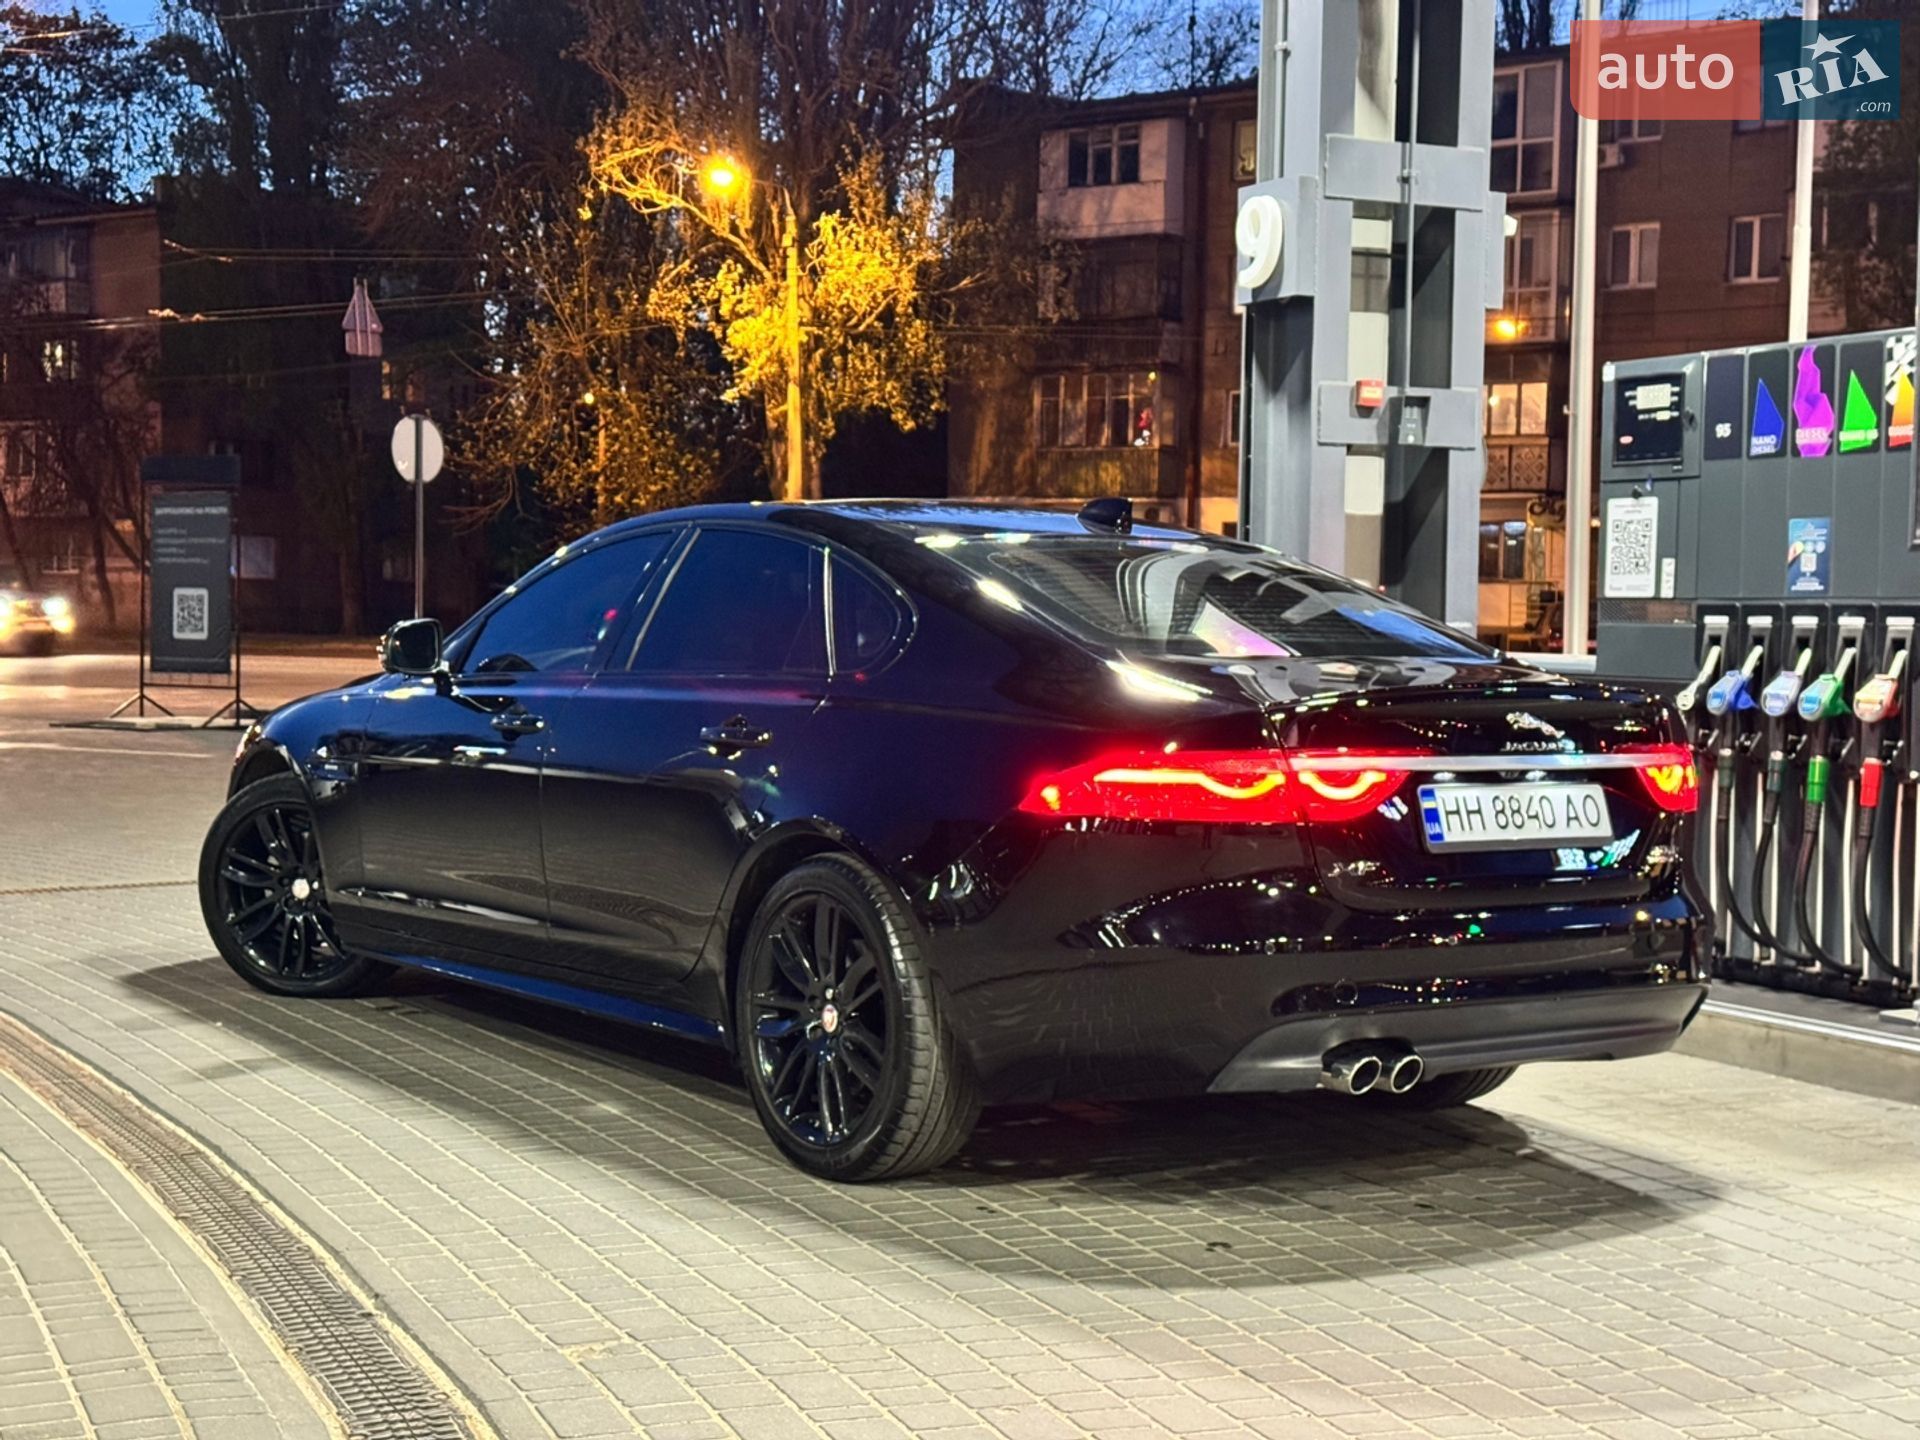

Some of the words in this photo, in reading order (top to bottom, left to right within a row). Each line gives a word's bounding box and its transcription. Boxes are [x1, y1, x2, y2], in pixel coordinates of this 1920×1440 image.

[1235, 195, 1283, 290] 9
[1715, 423, 1732, 438] 95
[1751, 434, 1777, 446] NANO
[1440, 796, 1487, 833] HH
[1492, 794, 1557, 830] 8840
[1566, 793, 1602, 829] AO
[1427, 822, 1442, 835] UA
